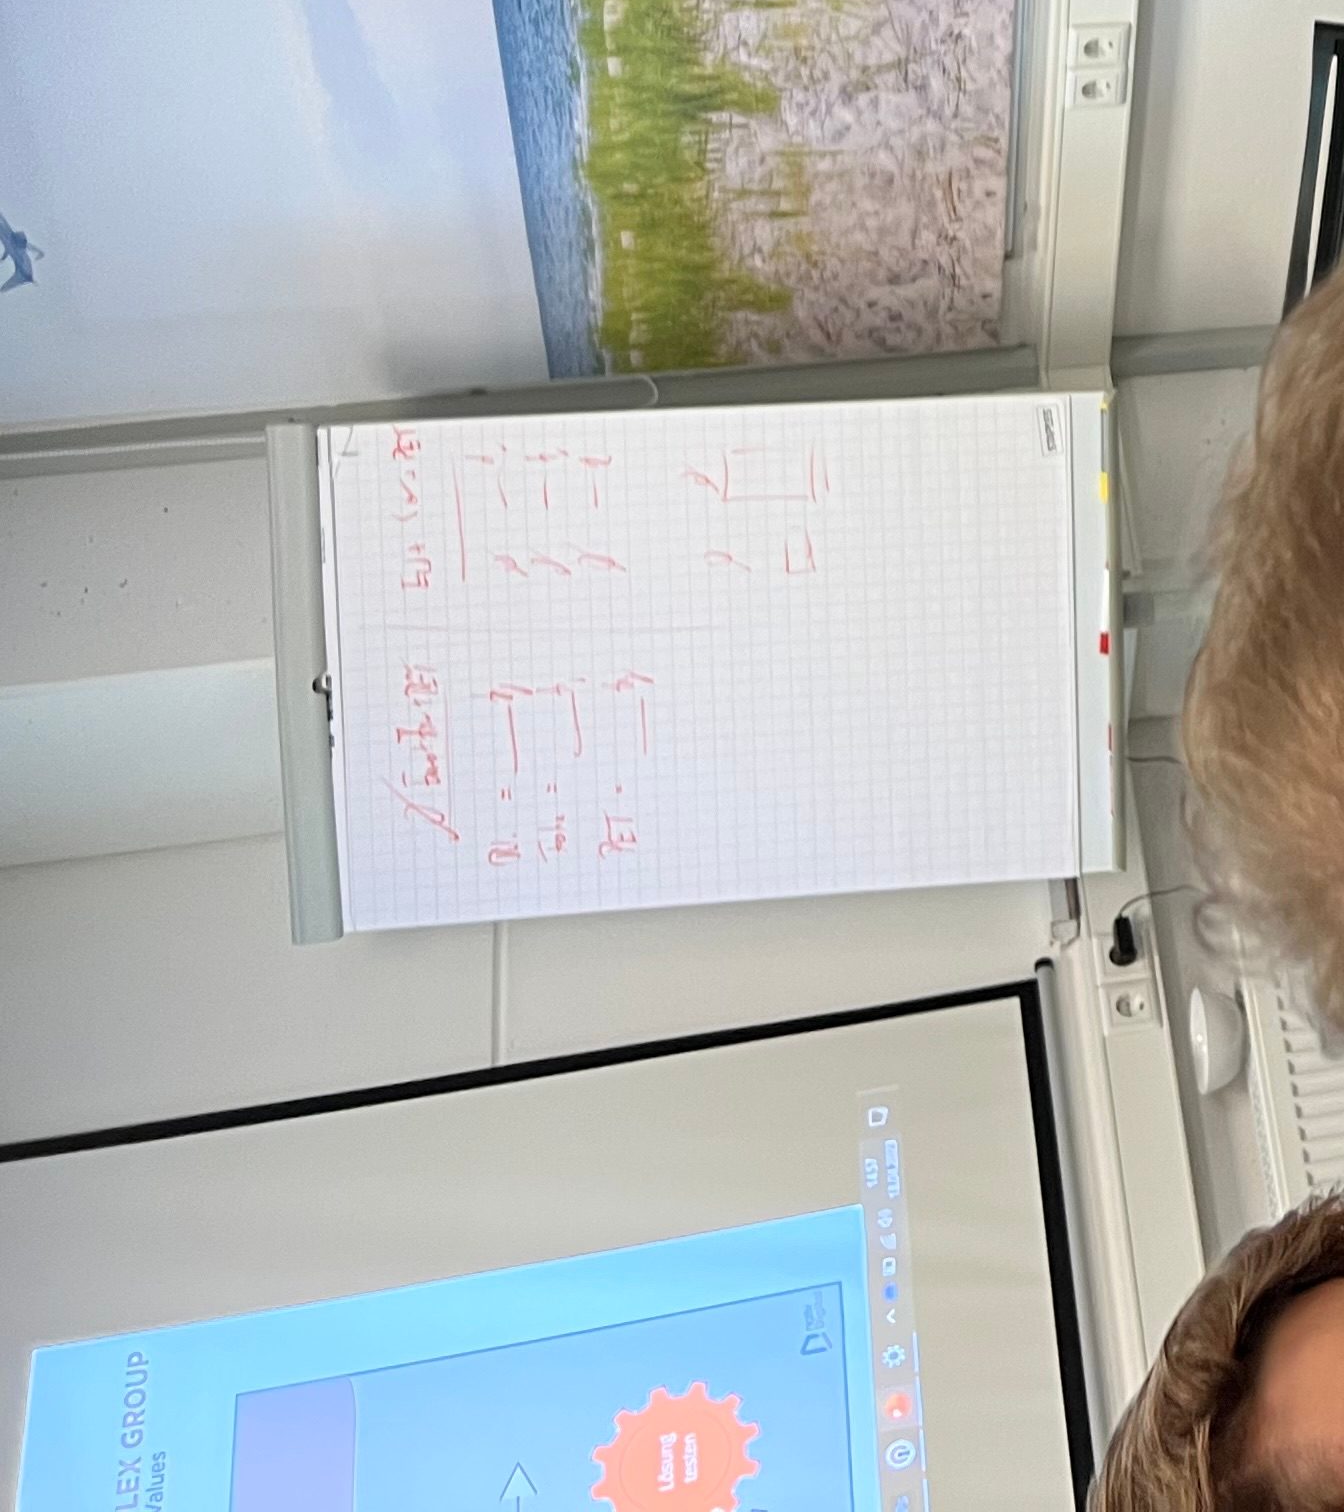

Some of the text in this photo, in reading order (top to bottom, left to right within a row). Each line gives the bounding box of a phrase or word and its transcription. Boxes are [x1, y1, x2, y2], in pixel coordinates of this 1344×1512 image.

[120, 1351, 149, 1449] GROUP
[657, 1432, 678, 1492] Lösung
[683, 1433, 698, 1484] testen
